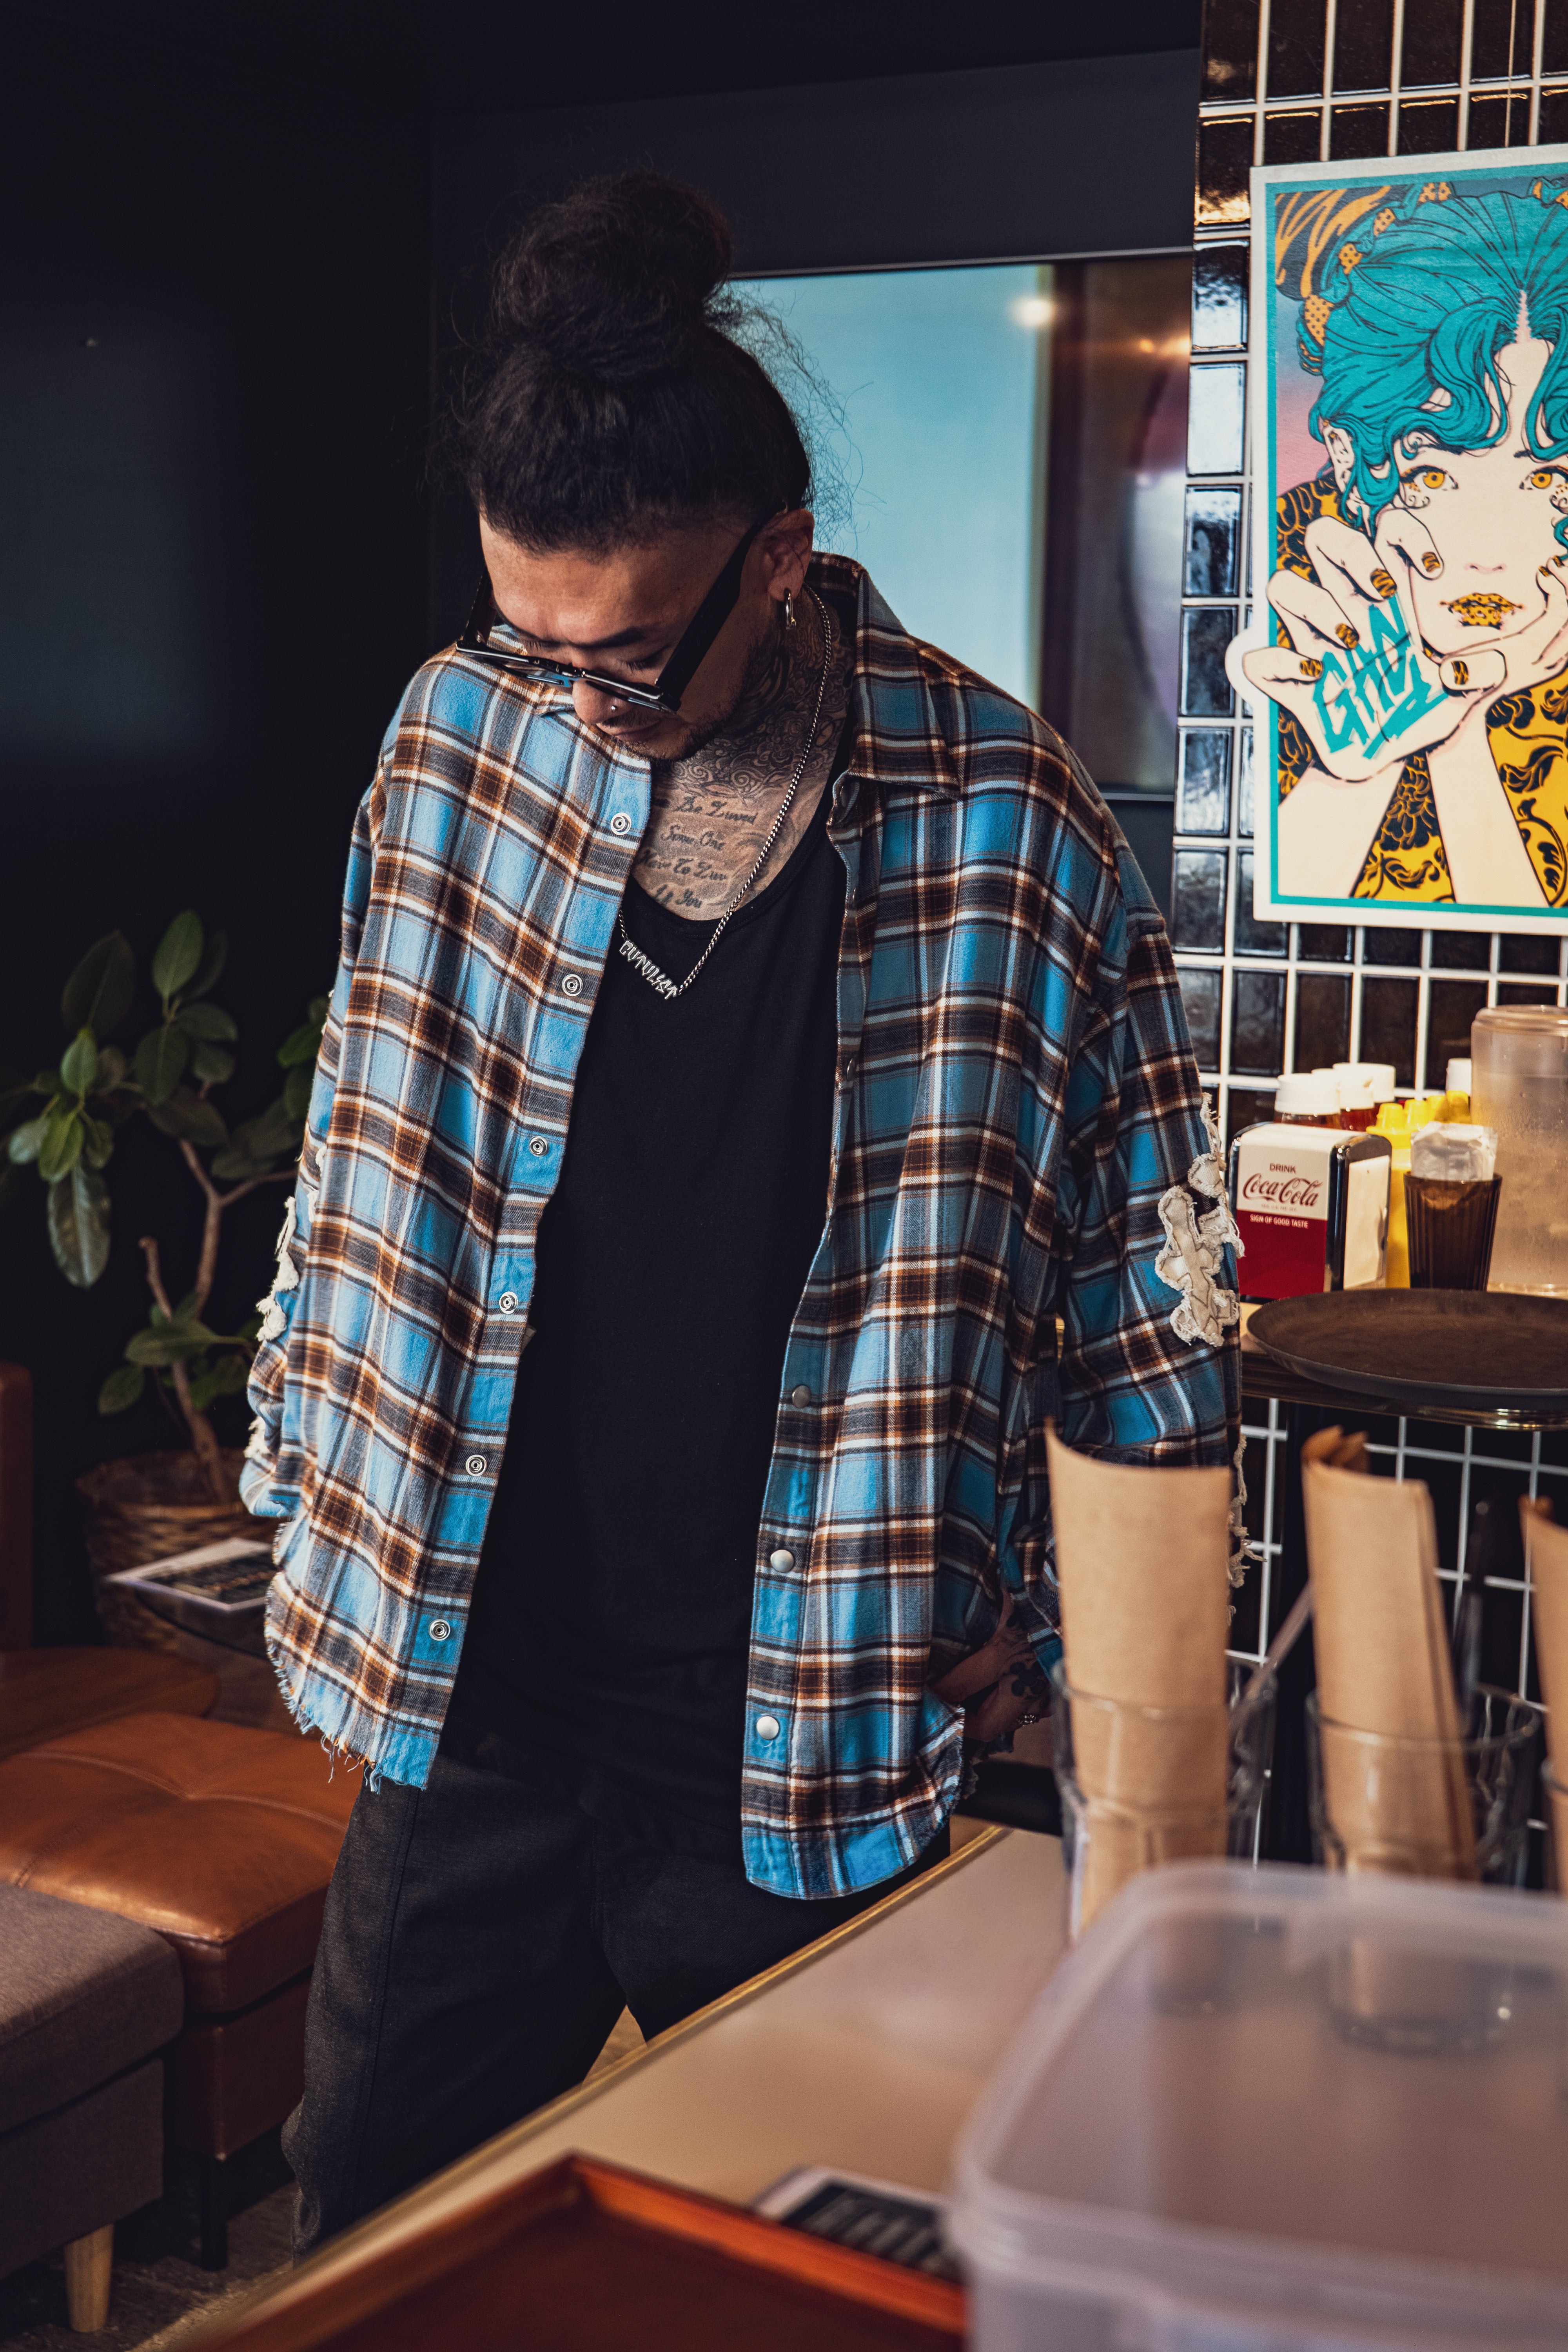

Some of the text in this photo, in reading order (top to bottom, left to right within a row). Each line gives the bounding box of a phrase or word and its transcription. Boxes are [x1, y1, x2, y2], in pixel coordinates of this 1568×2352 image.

[1269, 1163, 1296, 1174] DRINK
[1242, 1172, 1323, 1207] Coca-Cola
[1250, 1214, 1309, 1229] SIGN OF GOOD TASTE
